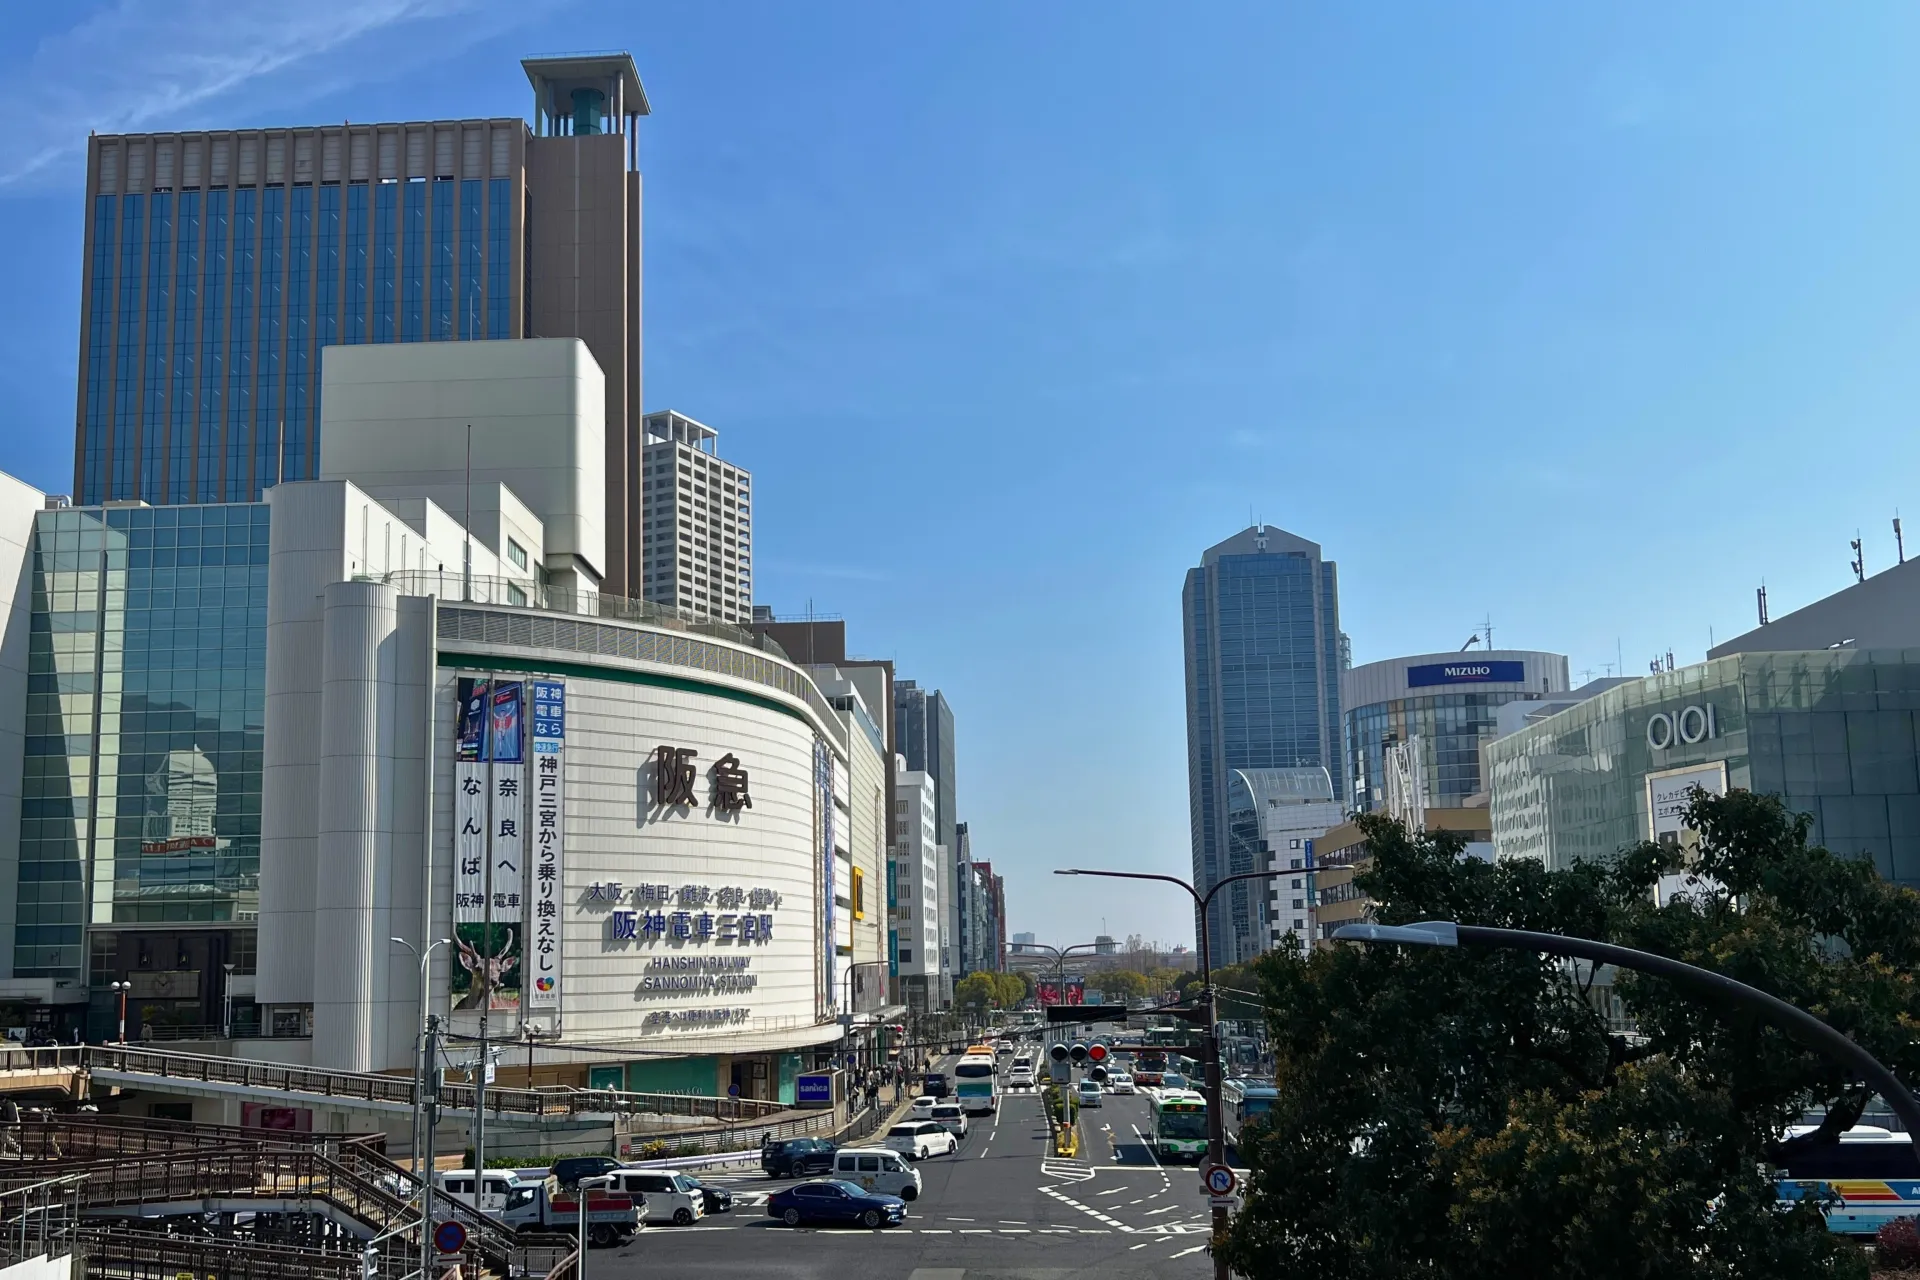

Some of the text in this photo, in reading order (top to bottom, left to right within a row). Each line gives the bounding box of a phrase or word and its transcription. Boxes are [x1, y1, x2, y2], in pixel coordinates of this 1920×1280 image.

[1444, 666, 1490, 676] MIZUHO
[536, 686, 562, 700] 阪神
[536, 704, 562, 717] 電車
[536, 722, 561, 735] なら
[657, 745, 752, 809] 阪急
[462, 776, 482, 876] なんば
[498, 778, 518, 873] 奈良へ
[537, 755, 558, 971] 神戸三宮から乗り換えなし
[612, 910, 773, 941] 阪神電車三宮駅
[653, 956, 751, 970] HANSHIN RAILWAY
[644, 975, 758, 990] SANNOMIYA STATION
